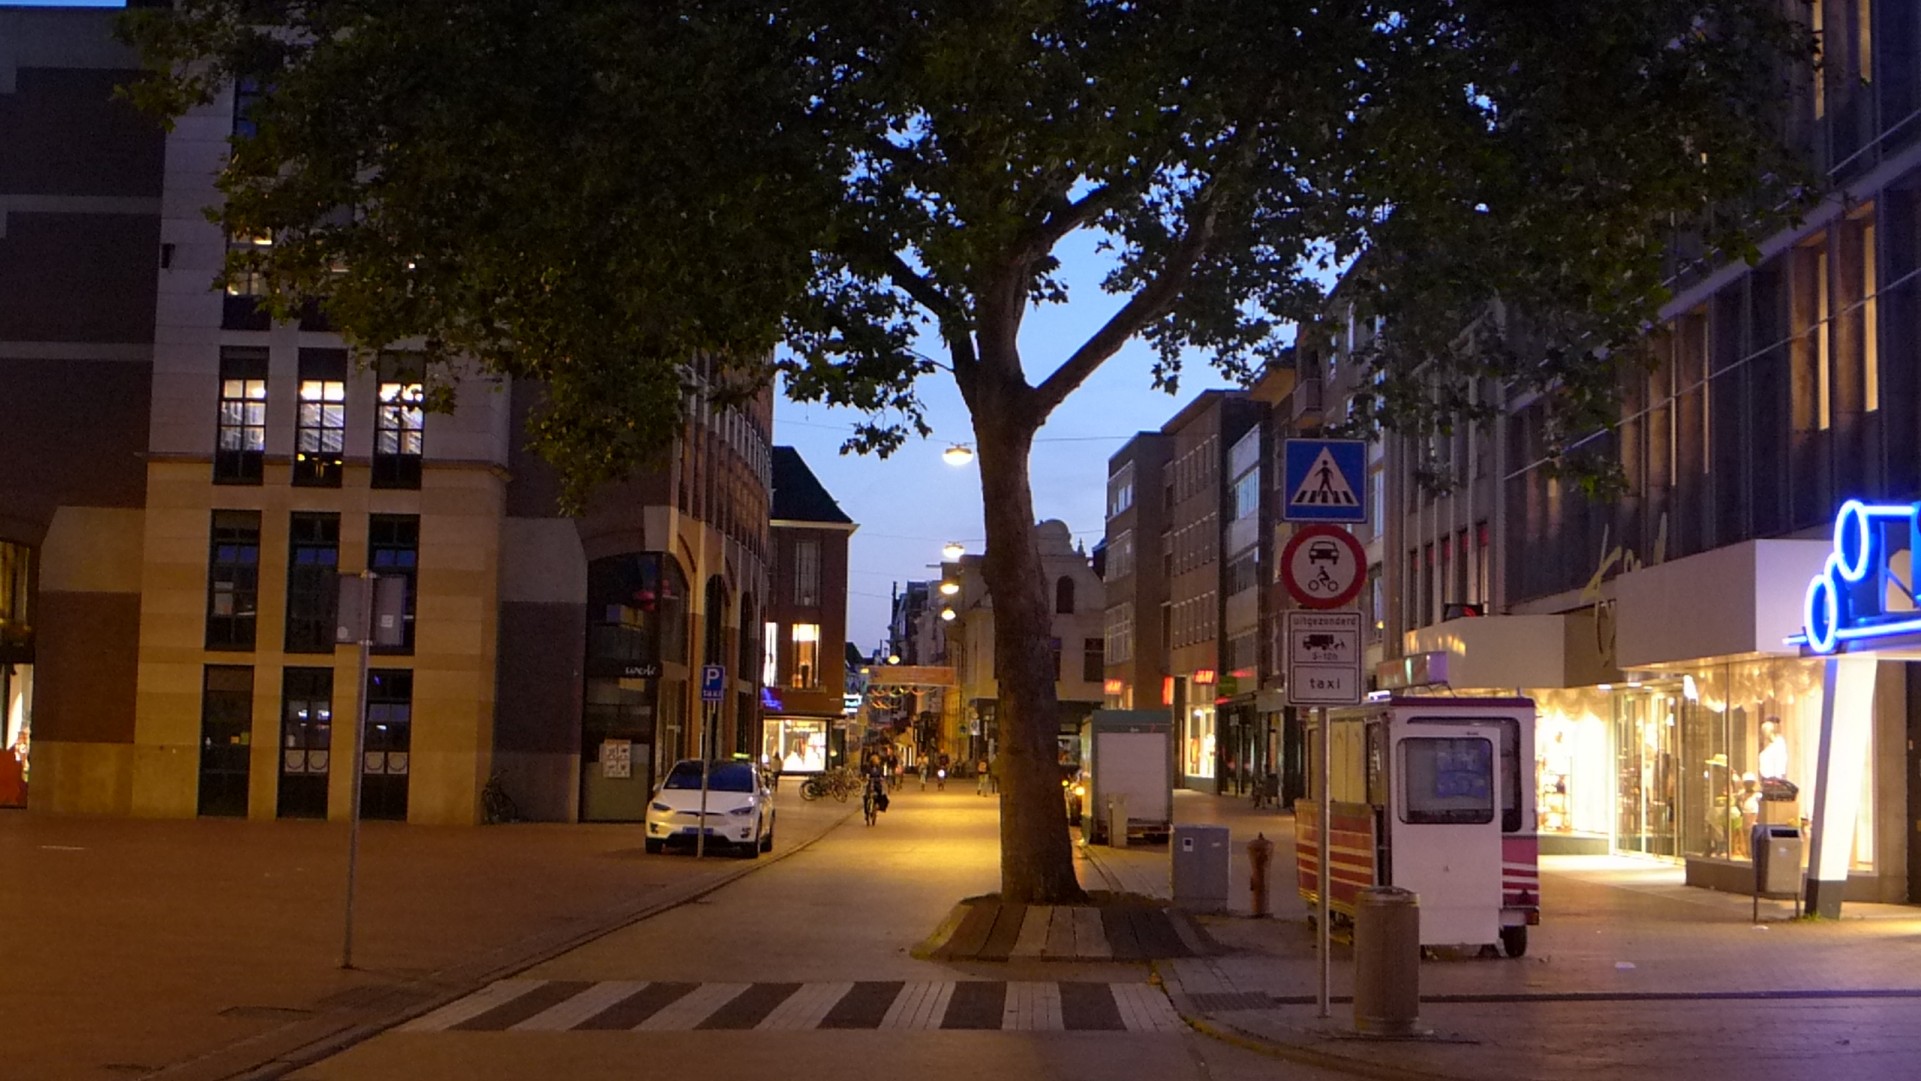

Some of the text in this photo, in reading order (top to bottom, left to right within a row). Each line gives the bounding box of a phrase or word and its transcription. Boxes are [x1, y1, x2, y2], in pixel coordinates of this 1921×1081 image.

[1293, 616, 1356, 627] uitgezonderd
[706, 668, 720, 686] P
[1309, 677, 1341, 689] taxi
